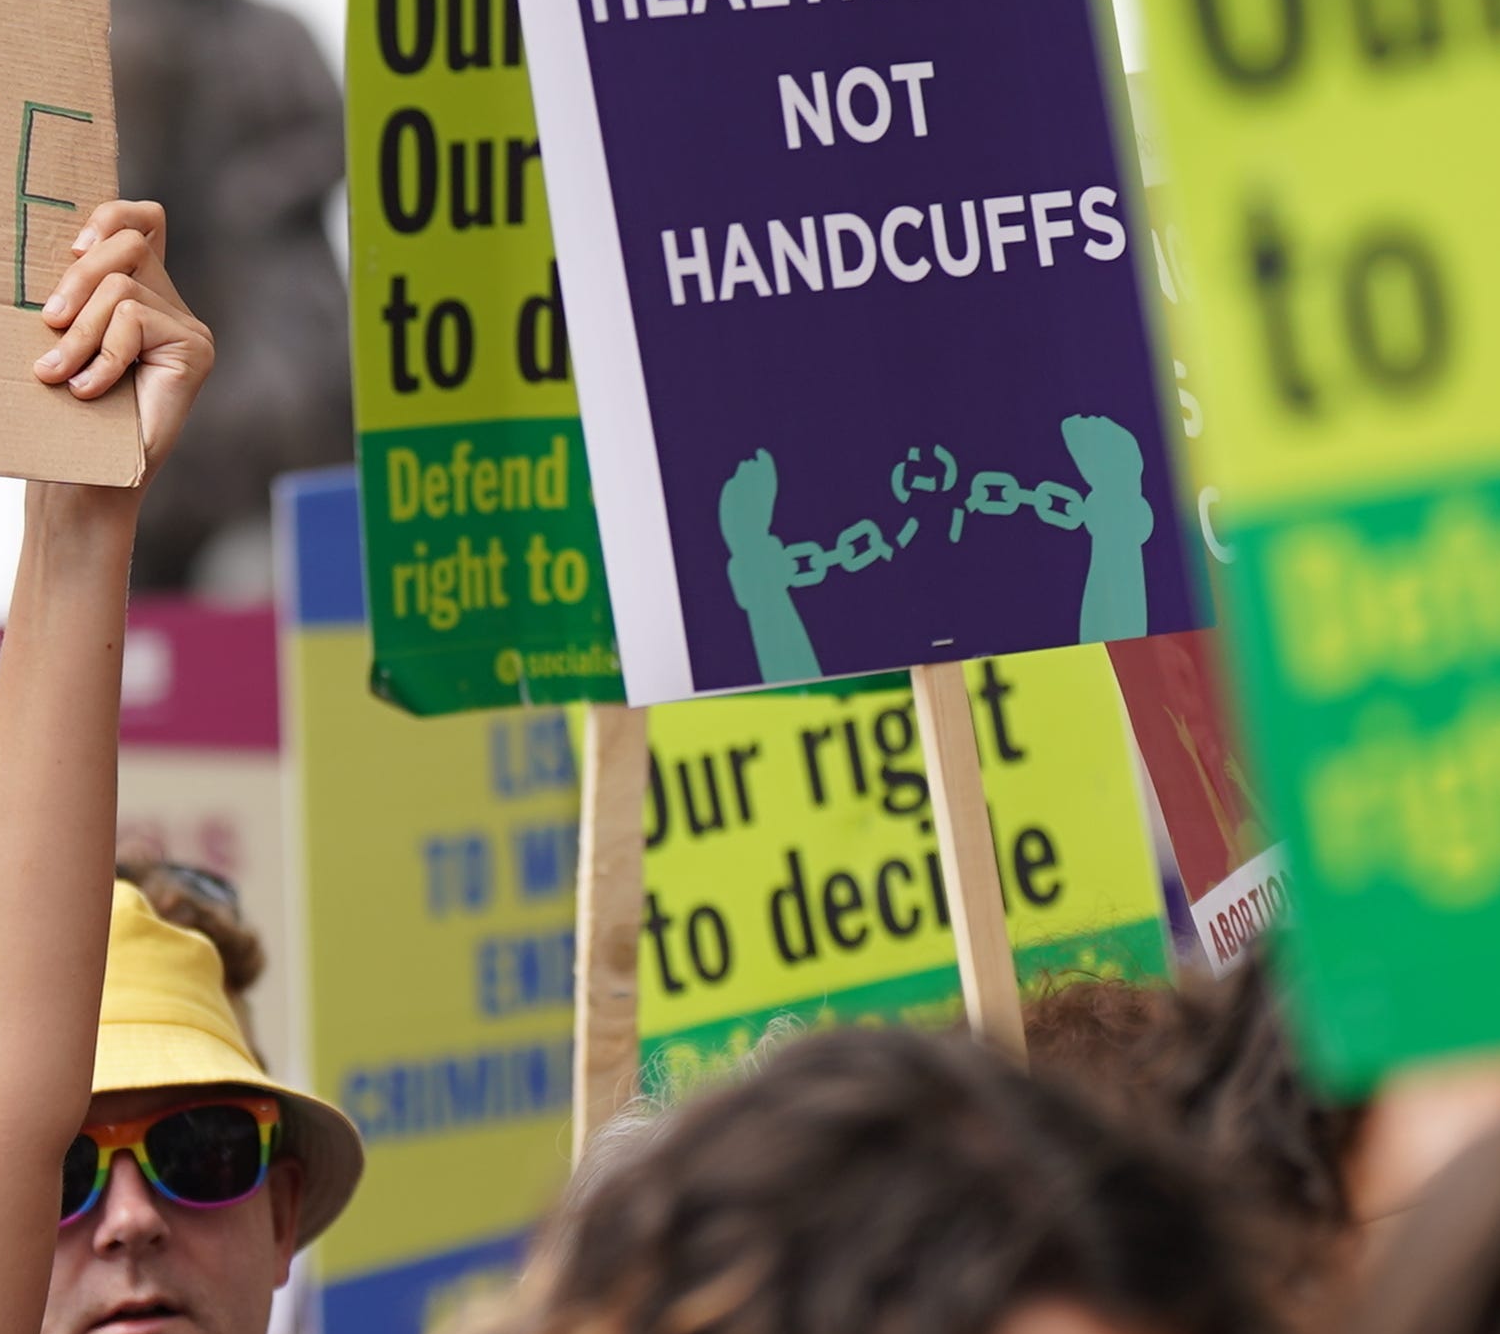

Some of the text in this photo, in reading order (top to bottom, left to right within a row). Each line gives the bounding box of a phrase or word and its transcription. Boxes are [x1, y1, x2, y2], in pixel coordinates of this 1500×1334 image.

[778, 61, 935, 149] NOT
[379, 105, 542, 237] Our
[661, 186, 1127, 306] HANDCUFFS
[382, 274, 474, 394] to
[1238, 193, 1457, 424] to
[387, 435, 569, 522] Defend
[393, 533, 589, 629] right to
[799, 659, 1026, 817] rigt
[643, 817, 1063, 996] to decie
